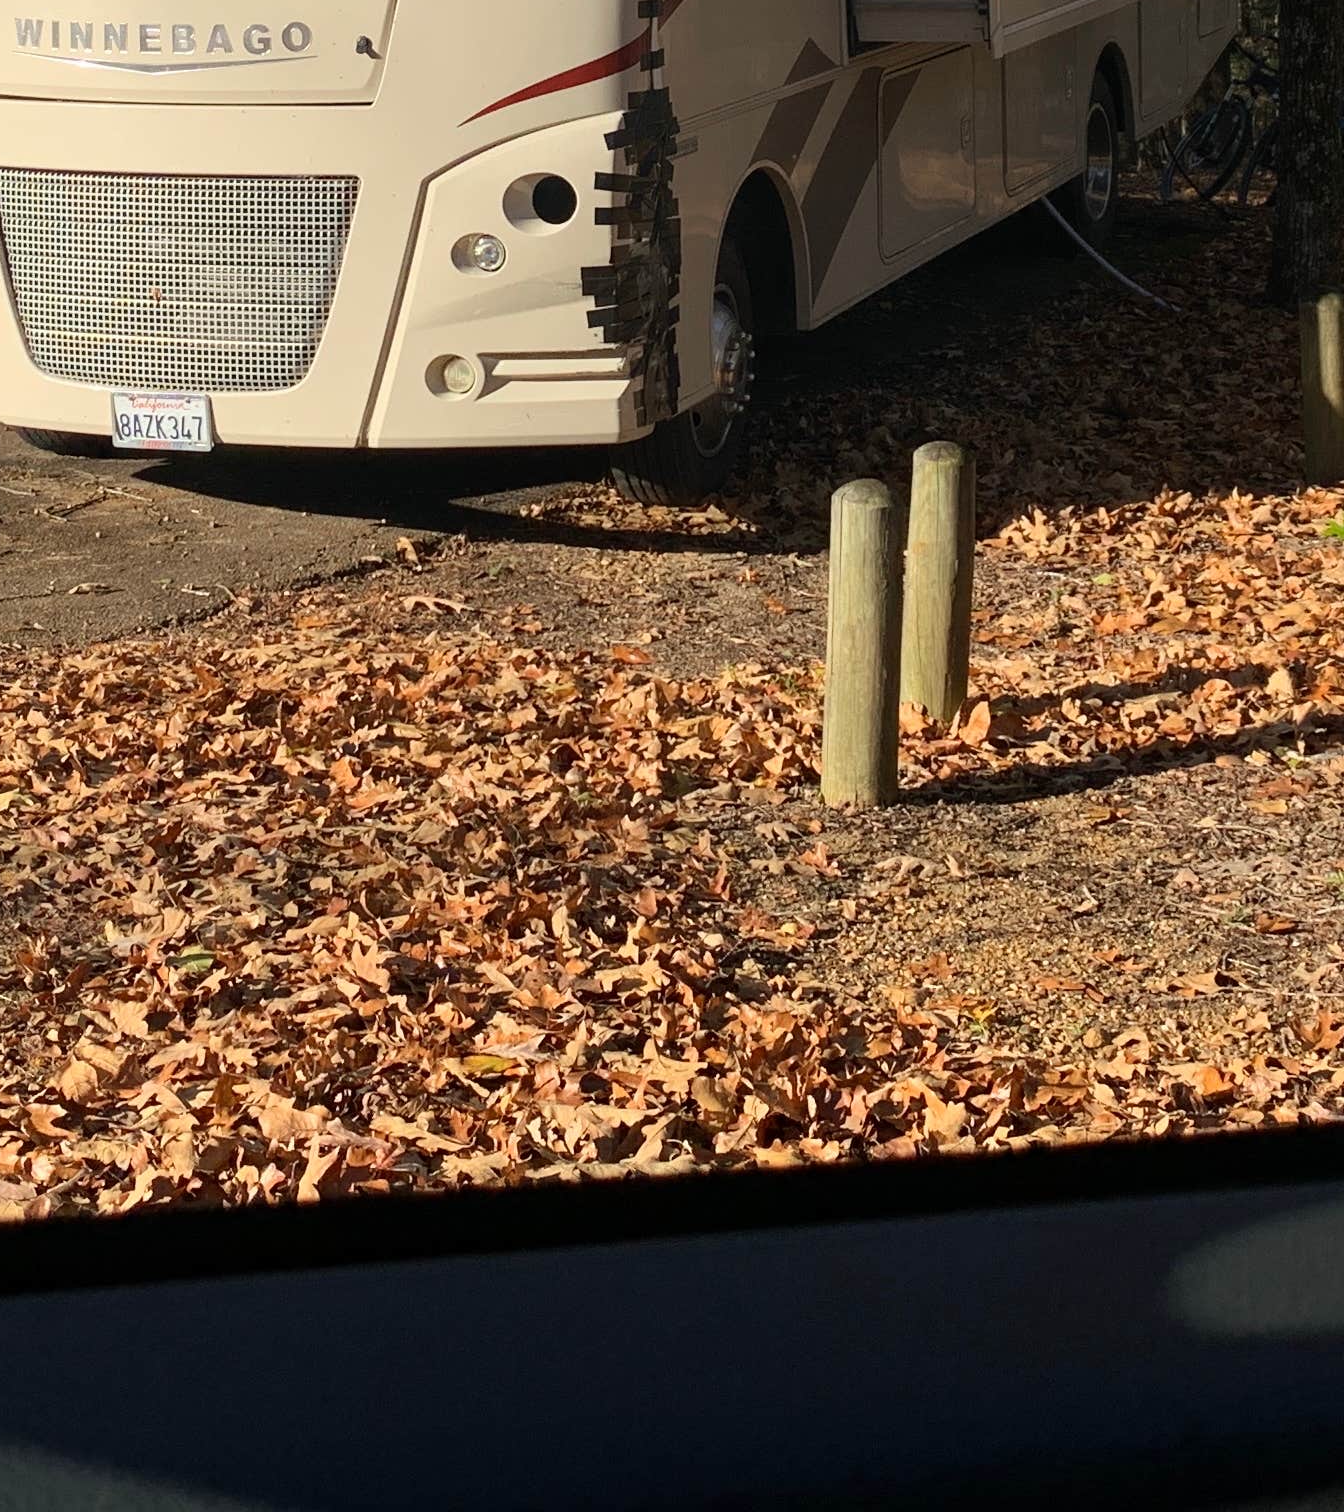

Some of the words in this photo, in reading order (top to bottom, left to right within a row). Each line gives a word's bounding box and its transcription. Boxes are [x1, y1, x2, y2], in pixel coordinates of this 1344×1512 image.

[14, 17, 313, 55] WINNEBAGO
[131, 396, 189, 413] California
[119, 413, 202, 441] 8AZK347
